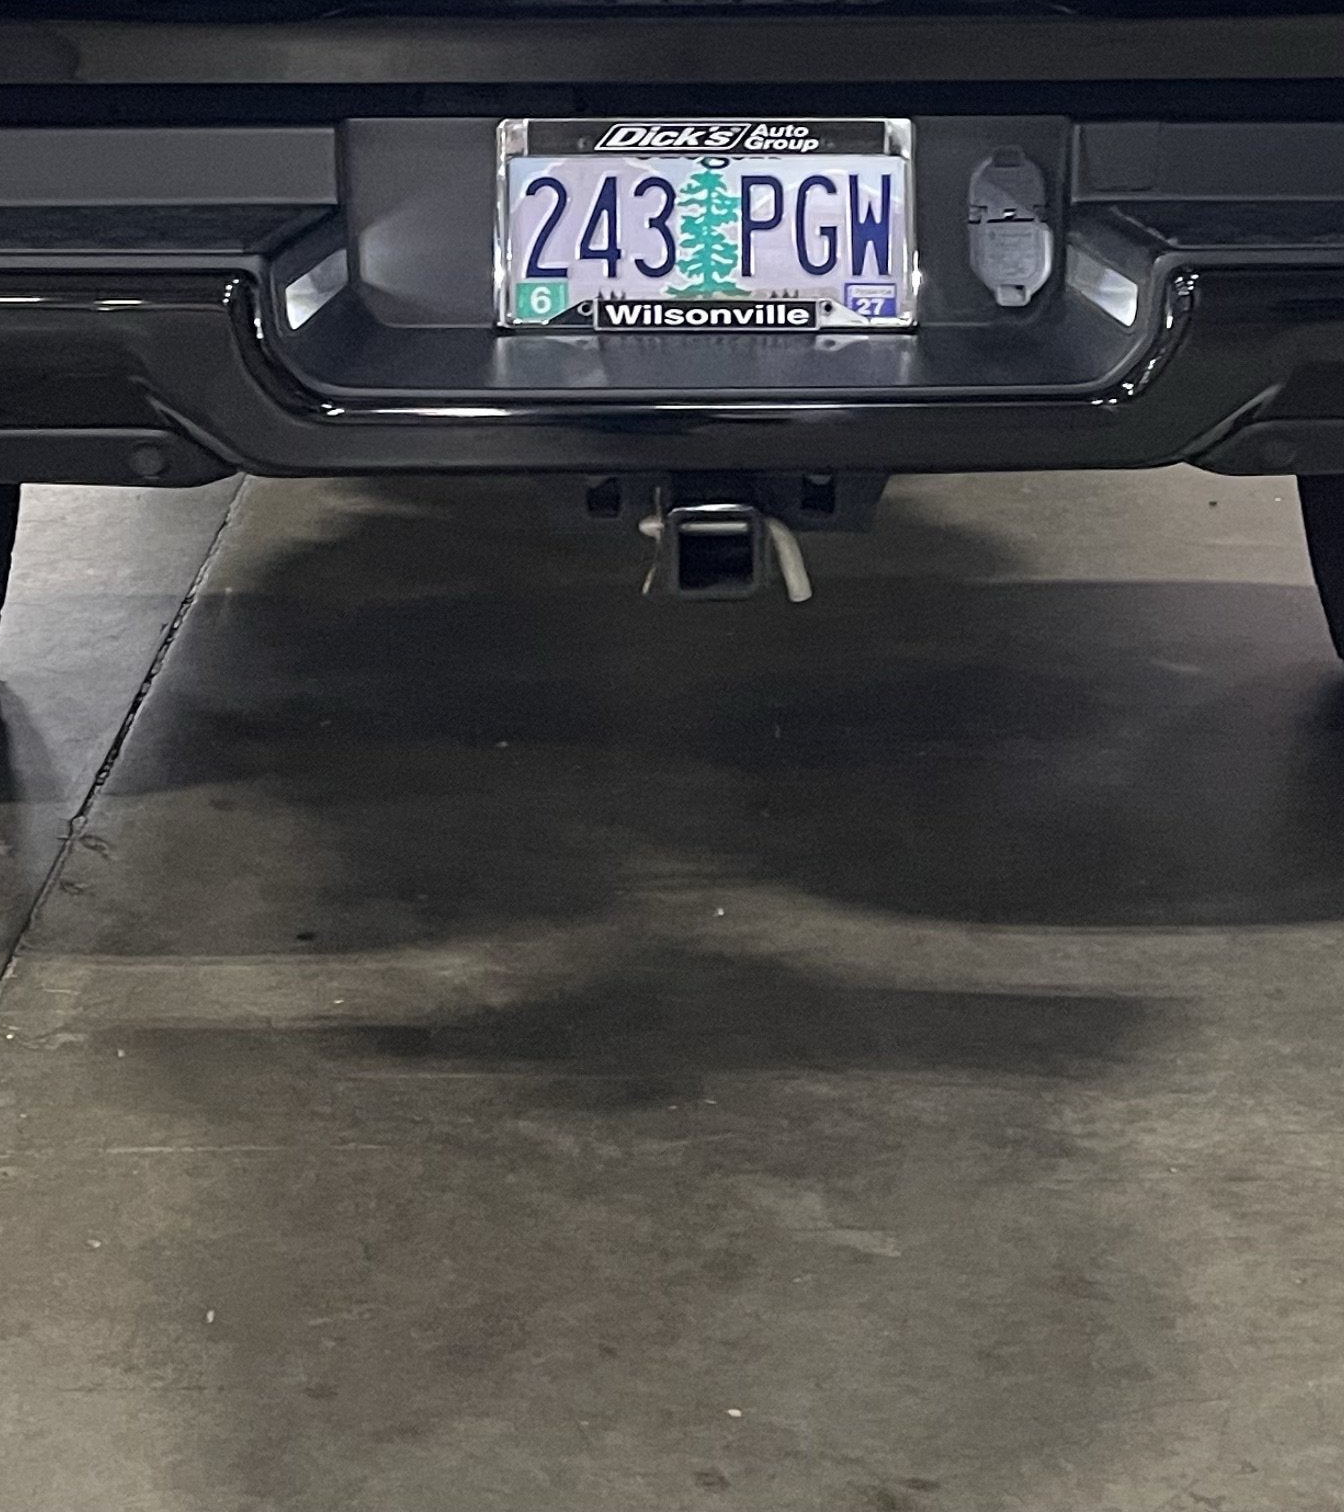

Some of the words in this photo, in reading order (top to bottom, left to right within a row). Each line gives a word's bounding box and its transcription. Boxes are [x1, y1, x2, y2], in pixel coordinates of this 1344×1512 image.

[607, 124, 736, 148] Dick's
[750, 124, 808, 138] Auto
[745, 137, 819, 153] Group
[524, 175, 677, 278] 243
[740, 174, 891, 277] PGW
[530, 287, 552, 315] 6
[856, 298, 886, 316] 27
[605, 304, 810, 327] Wilsonville
